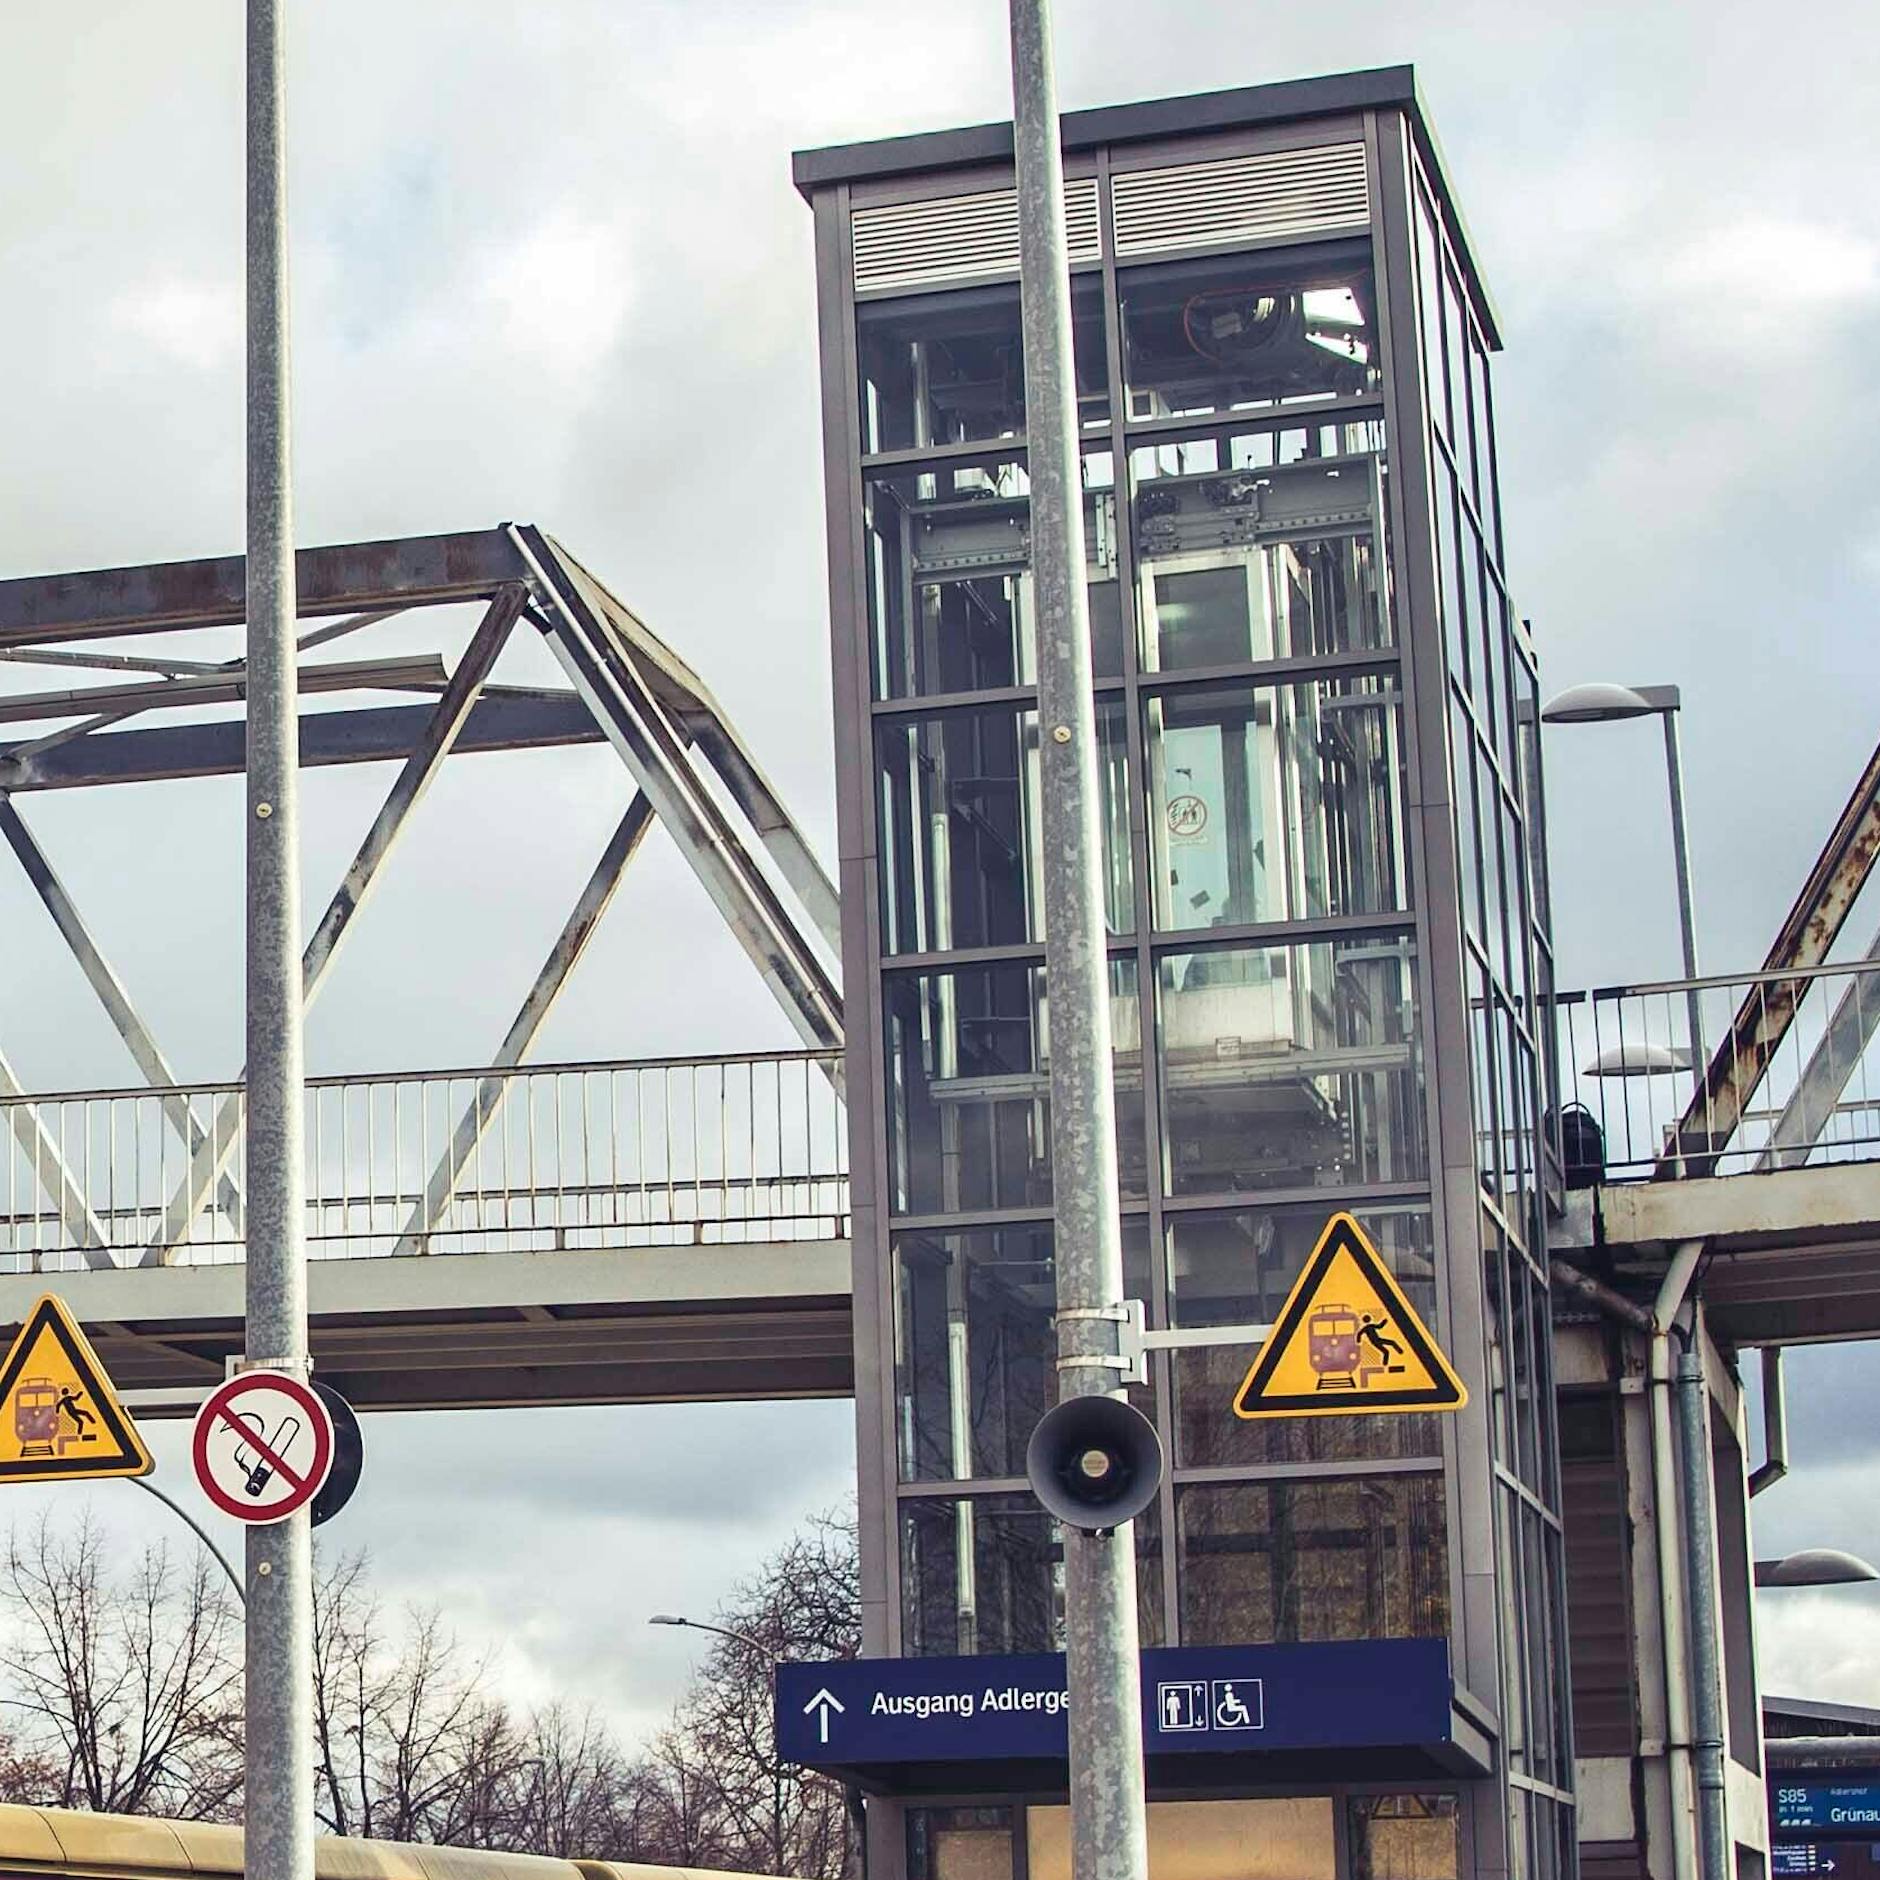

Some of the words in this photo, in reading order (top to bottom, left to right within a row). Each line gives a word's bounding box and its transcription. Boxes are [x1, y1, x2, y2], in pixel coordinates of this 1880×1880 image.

[871, 1692, 974, 1719] Ausgang
[980, 1687, 1069, 1714] Adlerge
[1778, 1789, 1807, 1803] S85
